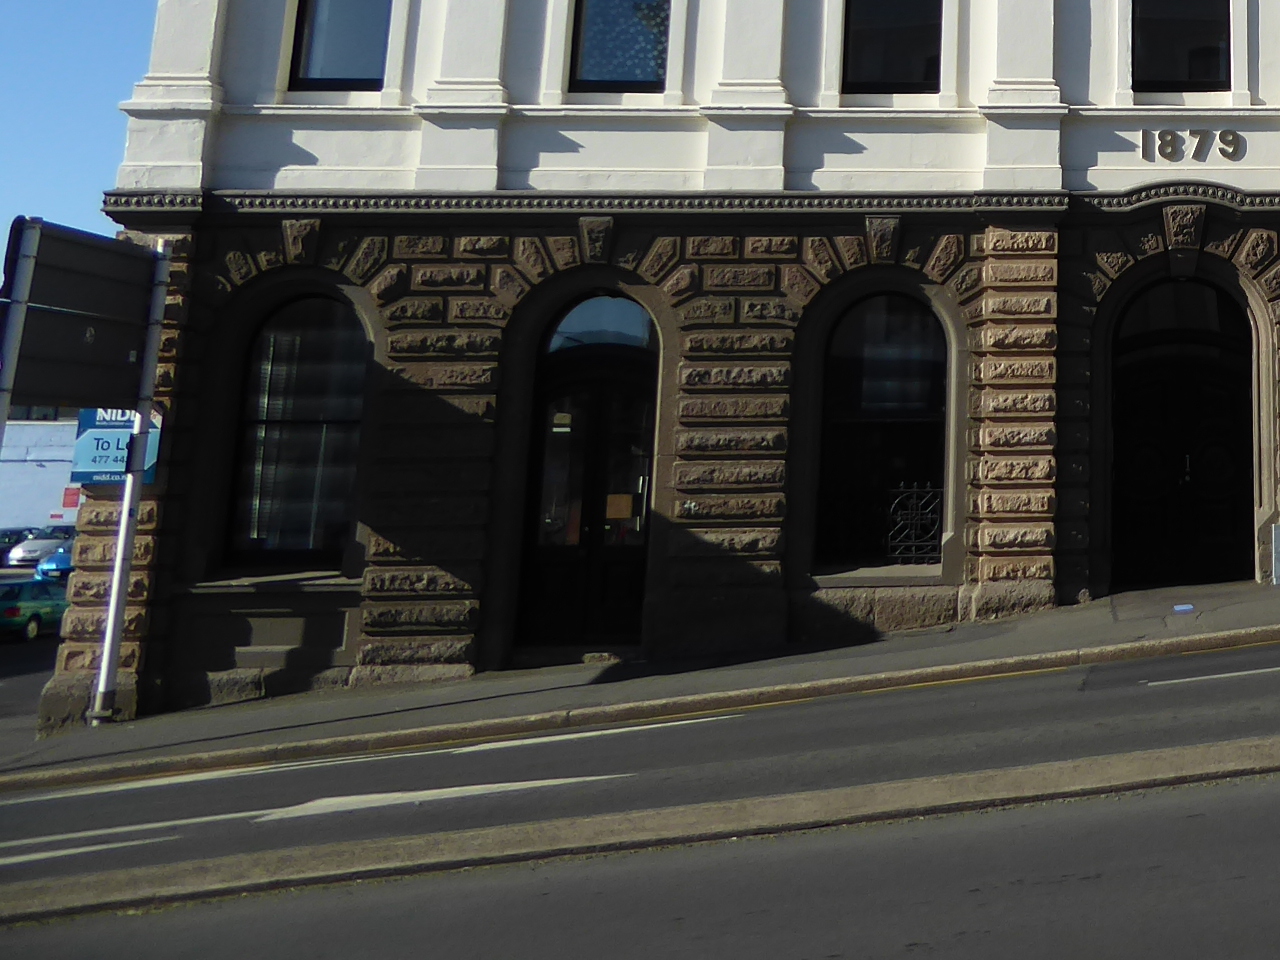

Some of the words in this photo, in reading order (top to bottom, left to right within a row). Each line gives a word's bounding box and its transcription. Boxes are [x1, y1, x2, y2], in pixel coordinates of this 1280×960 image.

[1141, 129, 1246, 162] 1879
[94, 437, 111, 451] To
[91, 455, 110, 464] 477
[112, 455, 127, 464] 44
